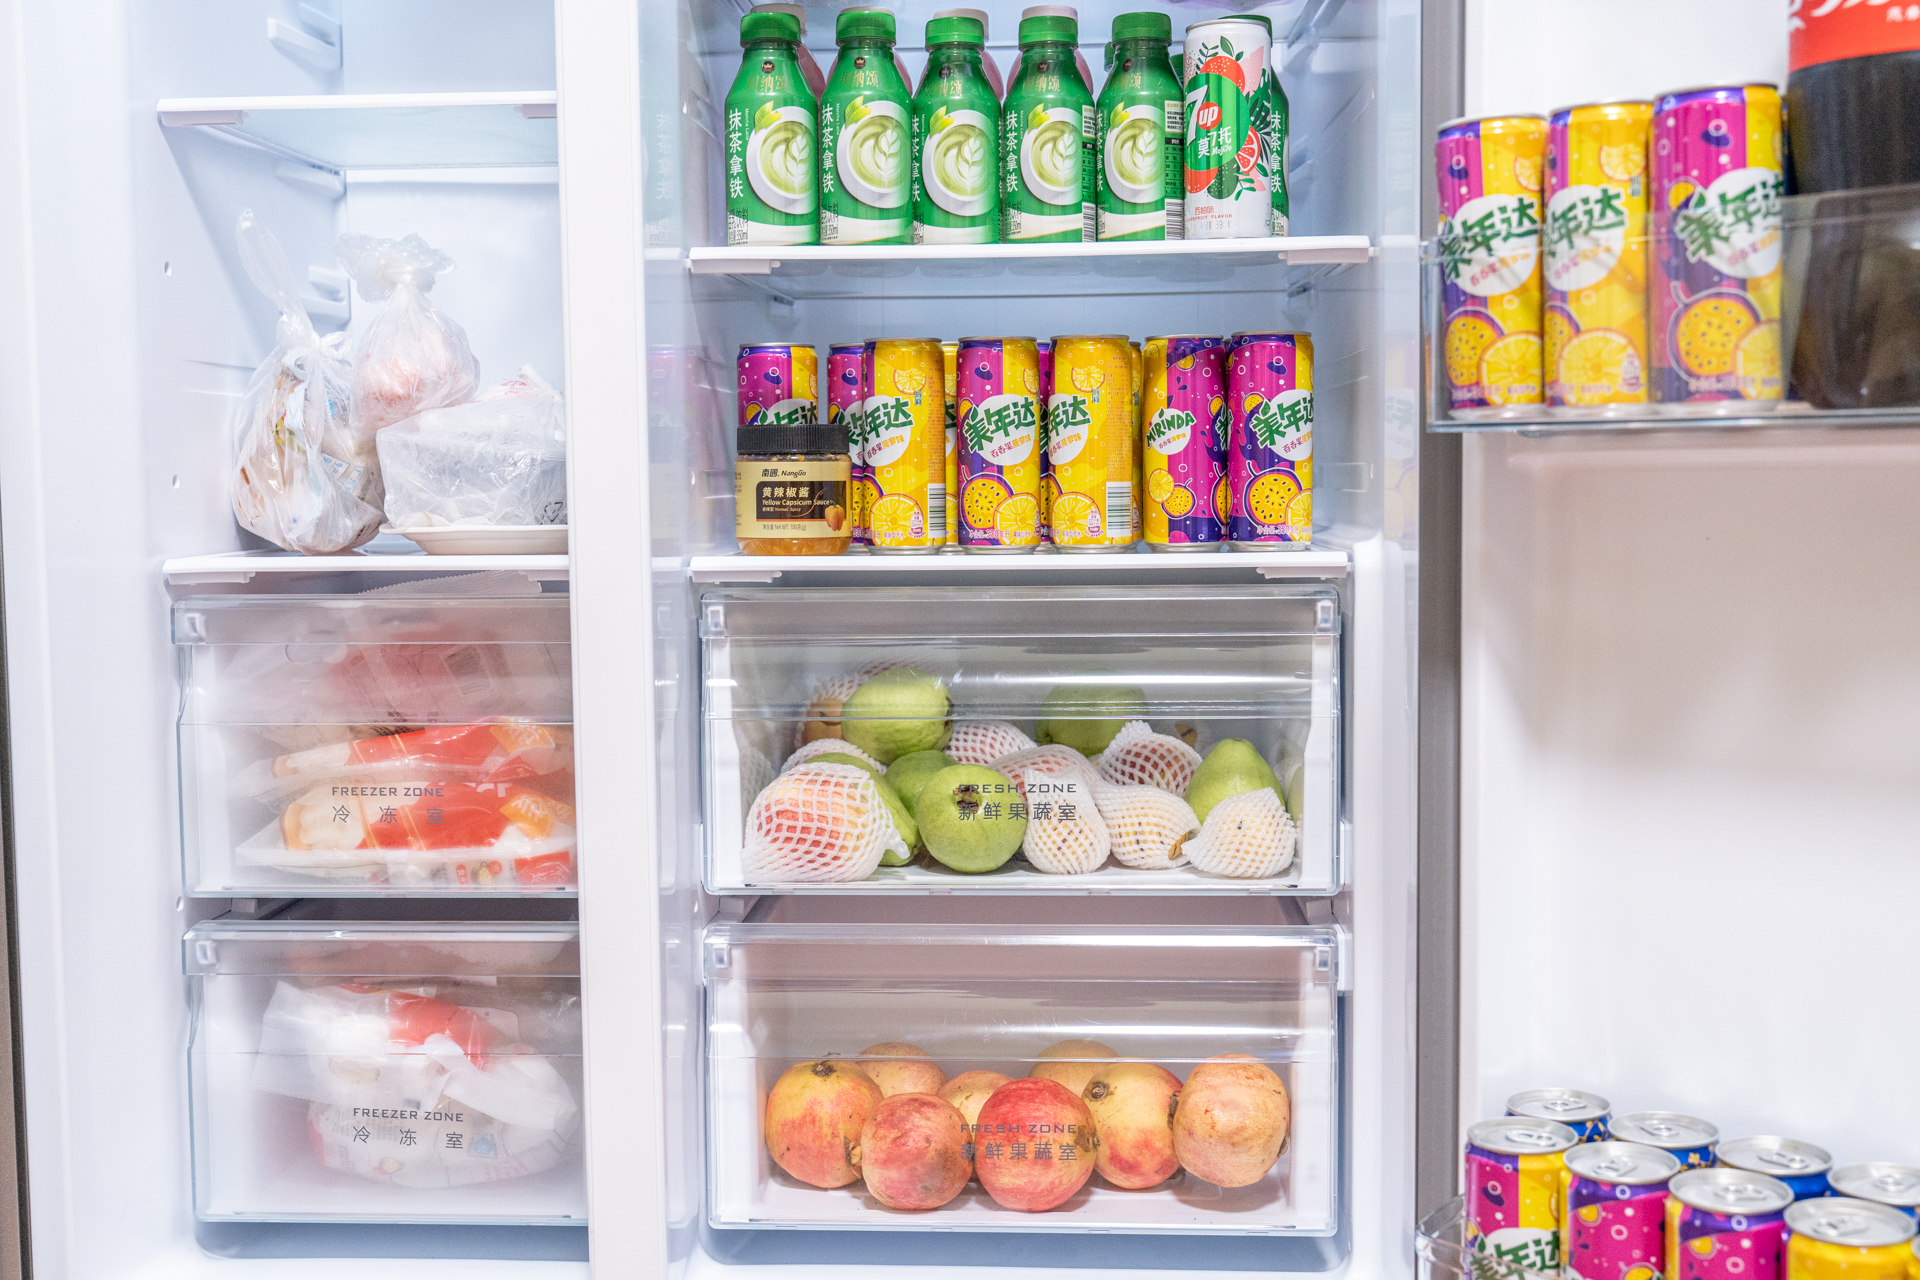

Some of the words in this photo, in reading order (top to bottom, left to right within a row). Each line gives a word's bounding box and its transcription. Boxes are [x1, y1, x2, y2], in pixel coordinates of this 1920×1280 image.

[729, 108, 744, 199] 抹茶拿铁
[822, 103, 834, 194] 抹茶拿铁
[1006, 110, 1018, 193] 抹茶拿铁
[1544, 188, 1625, 259] 年达
[863, 397, 914, 444] 年达
[964, 396, 1036, 452] 美年达
[1049, 395, 1091, 442] 年达
[1146, 411, 1196, 449] MIRINDA
[762, 486, 809, 498] 黄辣椒酱
[782, 499, 812, 507] Capsicum
[332, 786, 398, 797] FREEZER
[403, 787, 444, 797] ZONE
[958, 783, 1019, 794] FRESH
[1027, 783, 1077, 794] ZONE
[332, 804, 445, 825] 冷冻室
[958, 801, 1077, 821] 新鲜果蔬室
[353, 1107, 418, 1120] FREEZER
[424, 1111, 464, 1123] ZONE
[353, 1125, 464, 1149] 冷冻室
[960, 1124, 1020, 1134] FRESH
[1028, 1124, 1078, 1134] ZONE
[960, 1141, 1078, 1161] 新鲜果蔬室
